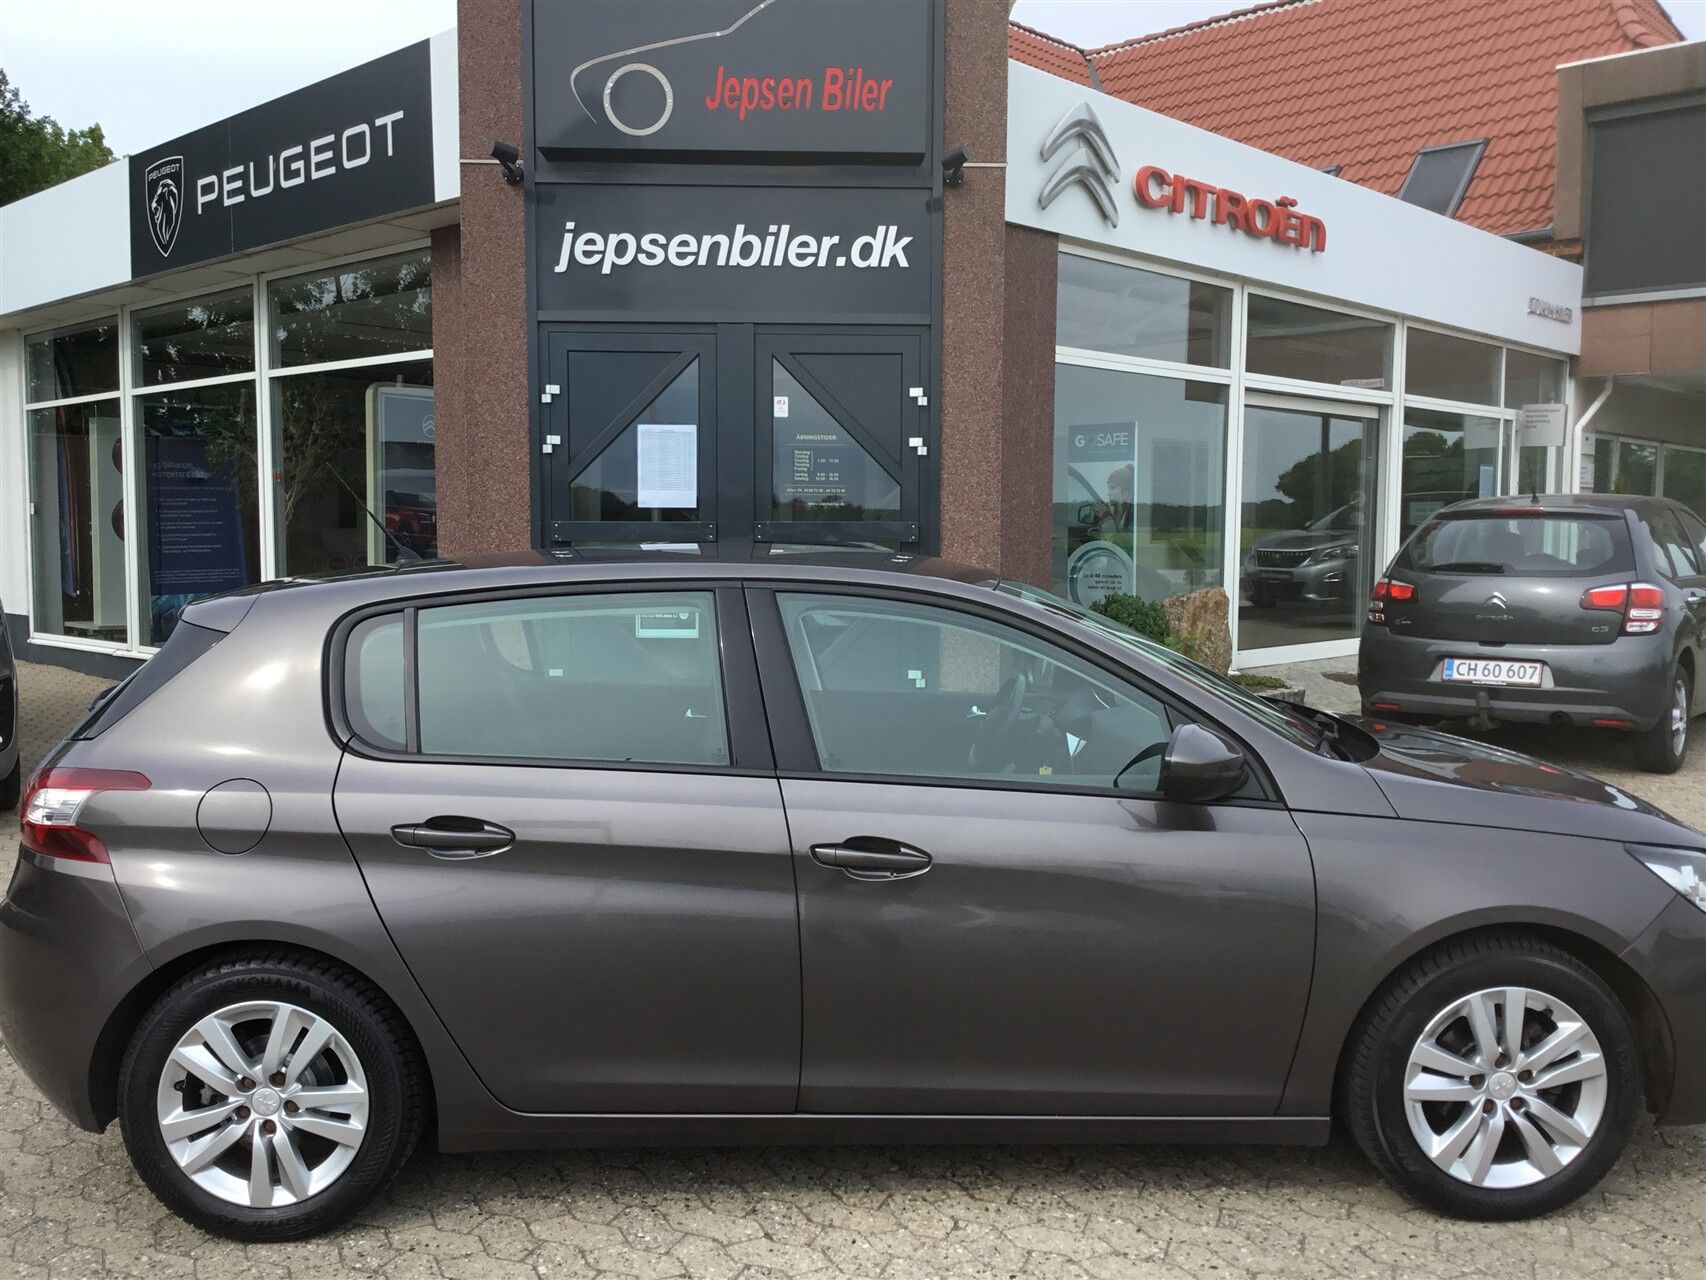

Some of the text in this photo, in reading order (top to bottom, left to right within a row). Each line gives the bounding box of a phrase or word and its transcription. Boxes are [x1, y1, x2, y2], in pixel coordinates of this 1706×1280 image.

[705, 65, 893, 121] Jepsen Biler
[148, 163, 180, 182] PEUGEOT
[197, 110, 404, 215] PEUGEOT
[554, 222, 914, 275] jepsenbiler.dk
[1096, 432, 1129, 447] SAFE
[1456, 662, 1539, 680] CH 60 607
